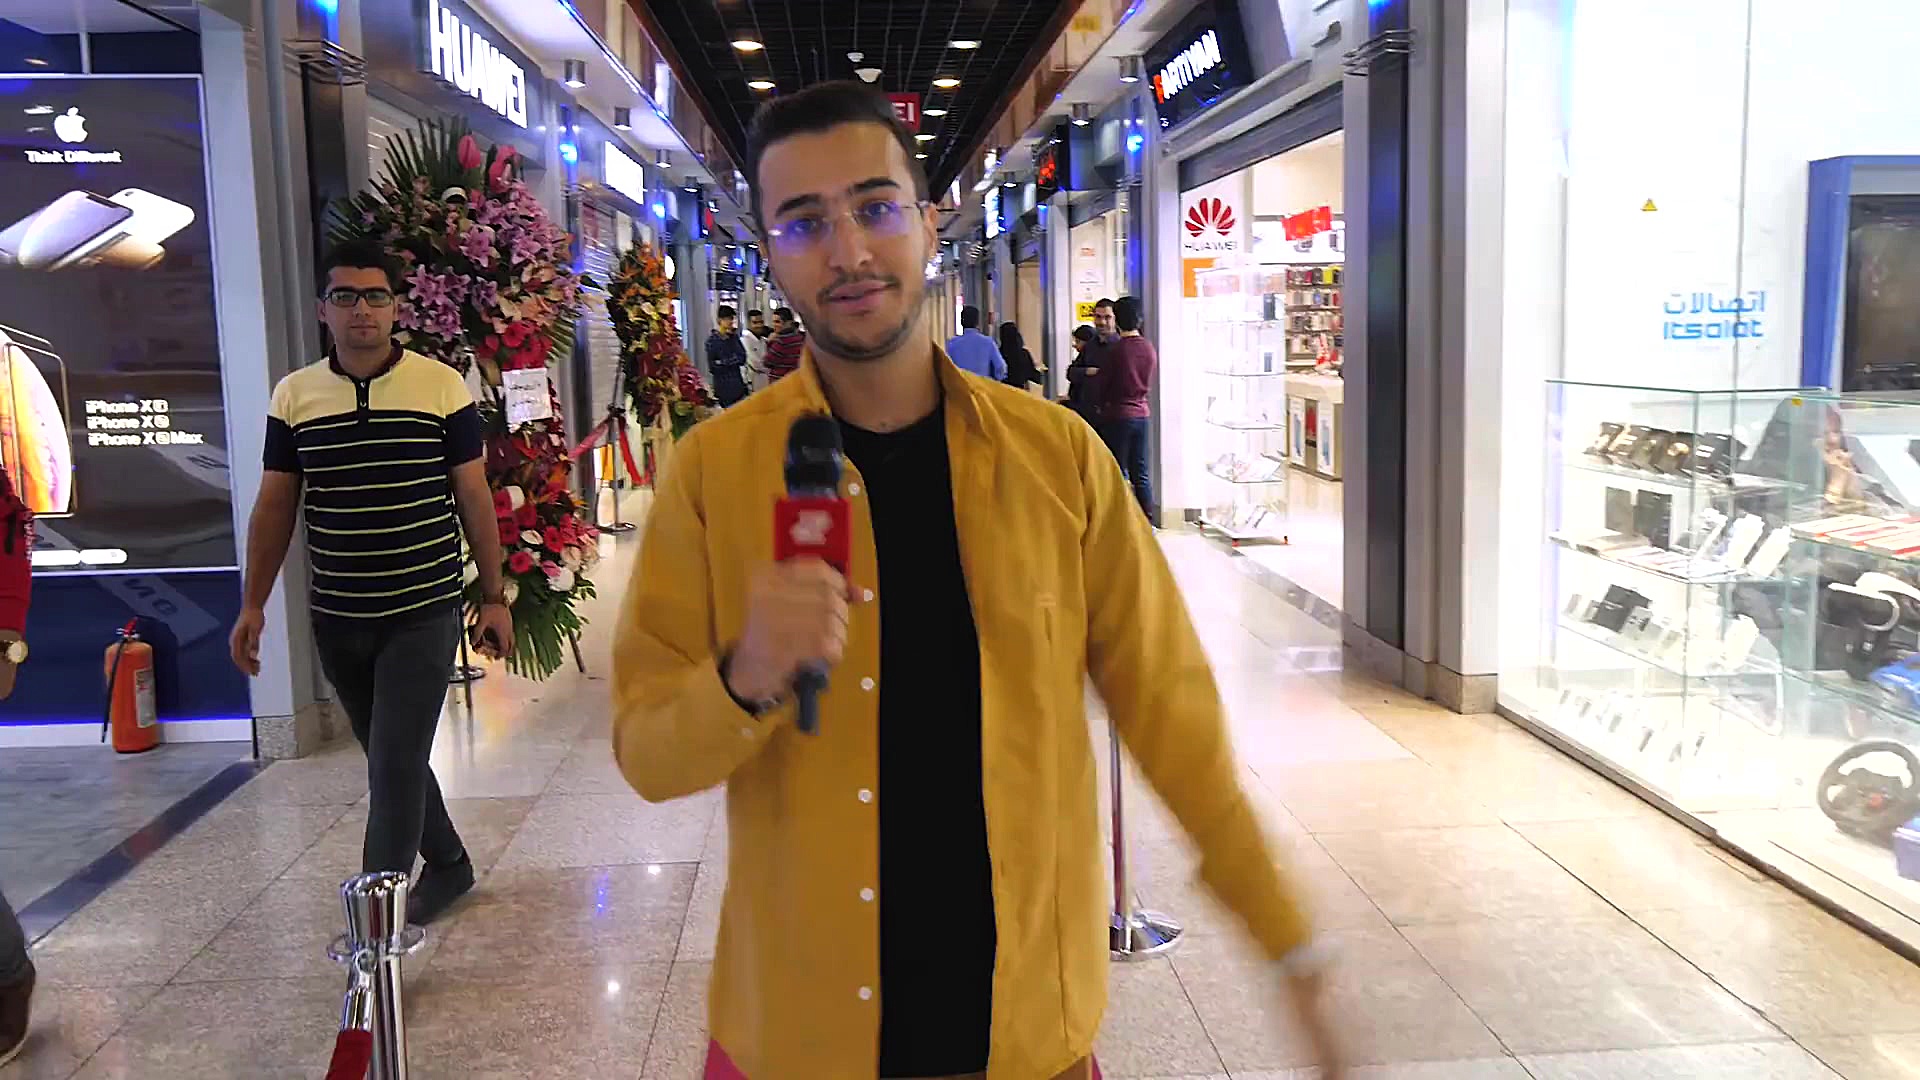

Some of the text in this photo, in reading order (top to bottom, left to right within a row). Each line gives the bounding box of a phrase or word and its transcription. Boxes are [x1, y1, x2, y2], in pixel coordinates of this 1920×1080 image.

[429, 0, 527, 129] HUAWEI
[24, 150, 122, 163] Think Different
[1184, 240, 1238, 251] HUAWEI
[1663, 291, 1765, 314] اتصالات
[86, 400, 139, 413] iPhone
[87, 416, 140, 429] iPhone
[88, 432, 141, 445] iPhone
[170, 431, 204, 444] Max
